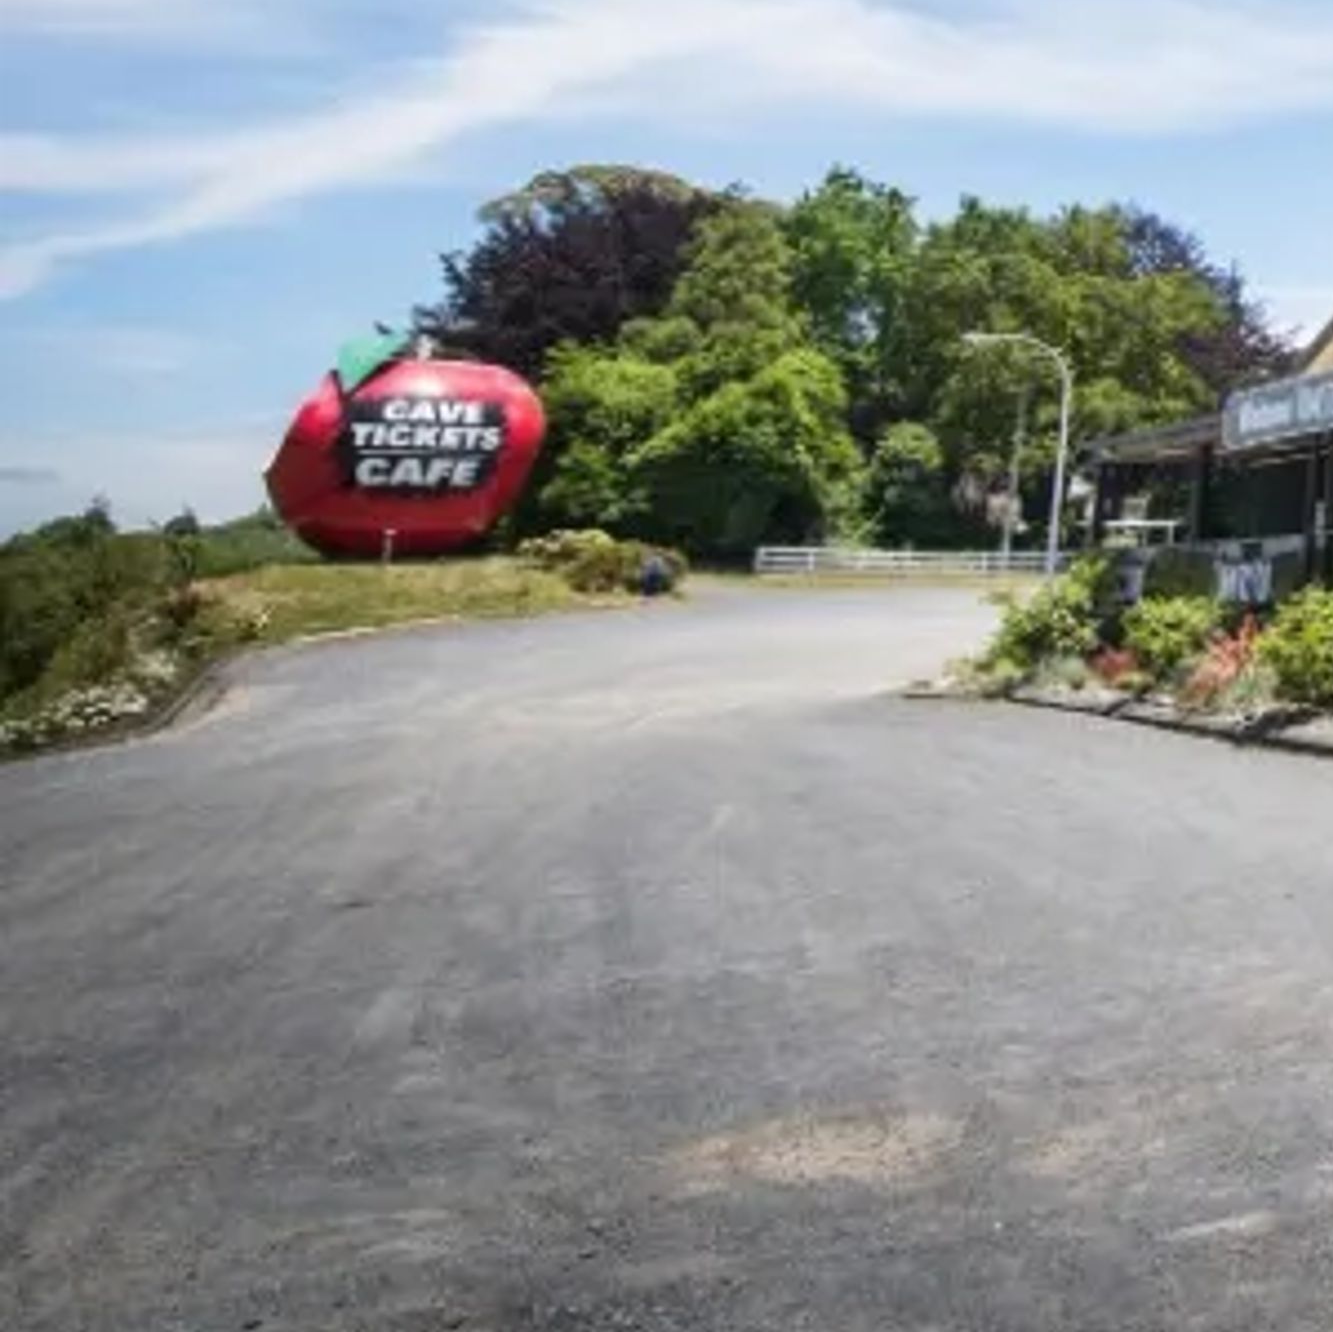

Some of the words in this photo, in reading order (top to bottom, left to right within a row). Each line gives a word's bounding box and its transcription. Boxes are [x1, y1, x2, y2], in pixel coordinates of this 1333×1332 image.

[383, 399, 484, 424] CAVE
[351, 422, 501, 451] TICKETS
[355, 456, 480, 487] CAFE
